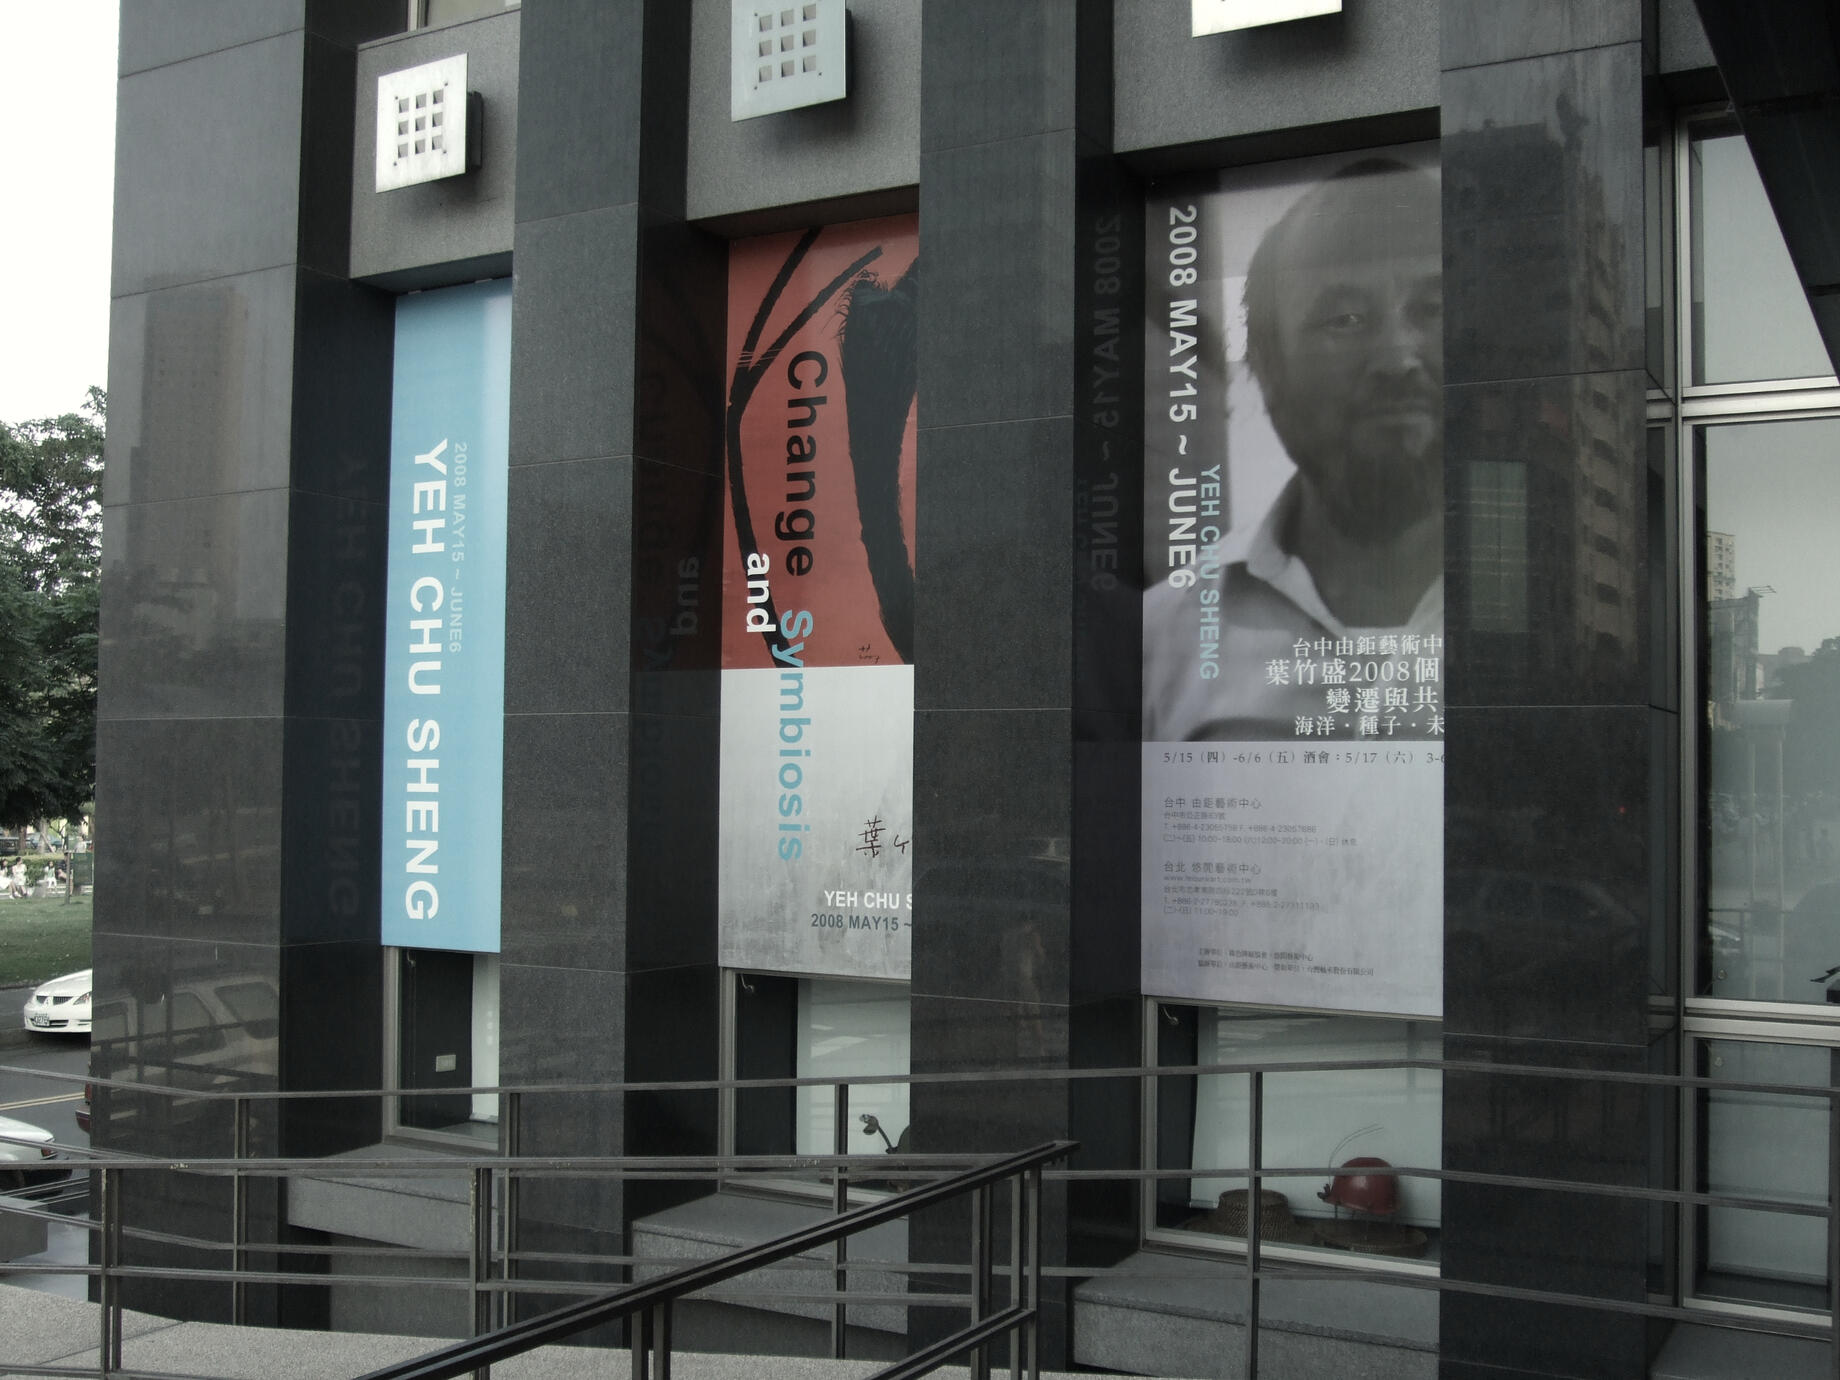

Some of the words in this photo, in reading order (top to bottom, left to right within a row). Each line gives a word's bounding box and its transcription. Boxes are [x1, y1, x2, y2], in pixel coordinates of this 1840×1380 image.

[1168, 205, 1198, 288] 2008
[1168, 299, 1198, 423] MAY15
[412, 438, 448, 554] YEH
[454, 441, 468, 487] 2008
[775, 349, 828, 578] Change
[1200, 464, 1221, 516] YEH
[452, 494, 466, 563] MAY15
[1168, 468, 1198, 590] JUNE6
[1200, 525, 1221, 581] CHU
[449, 586, 464, 654] JUNE6
[746, 552, 777, 633] and
[408, 576, 445, 695] CHU
[1199, 589, 1220, 681] SHENG
[1265, 658, 1440, 685] 葉竹盛2008個
[1293, 634, 1442, 657] 台中由鉅藝術中
[772, 608, 814, 862] Symbiosis
[1326, 686, 1440, 713] 變遷與共
[405, 718, 442, 921] SHENG
[811, 913, 844, 929] 2008
[848, 915, 899, 931] MAY15
[824, 890, 858, 908] YEH
[863, 892, 900, 910] CHU
